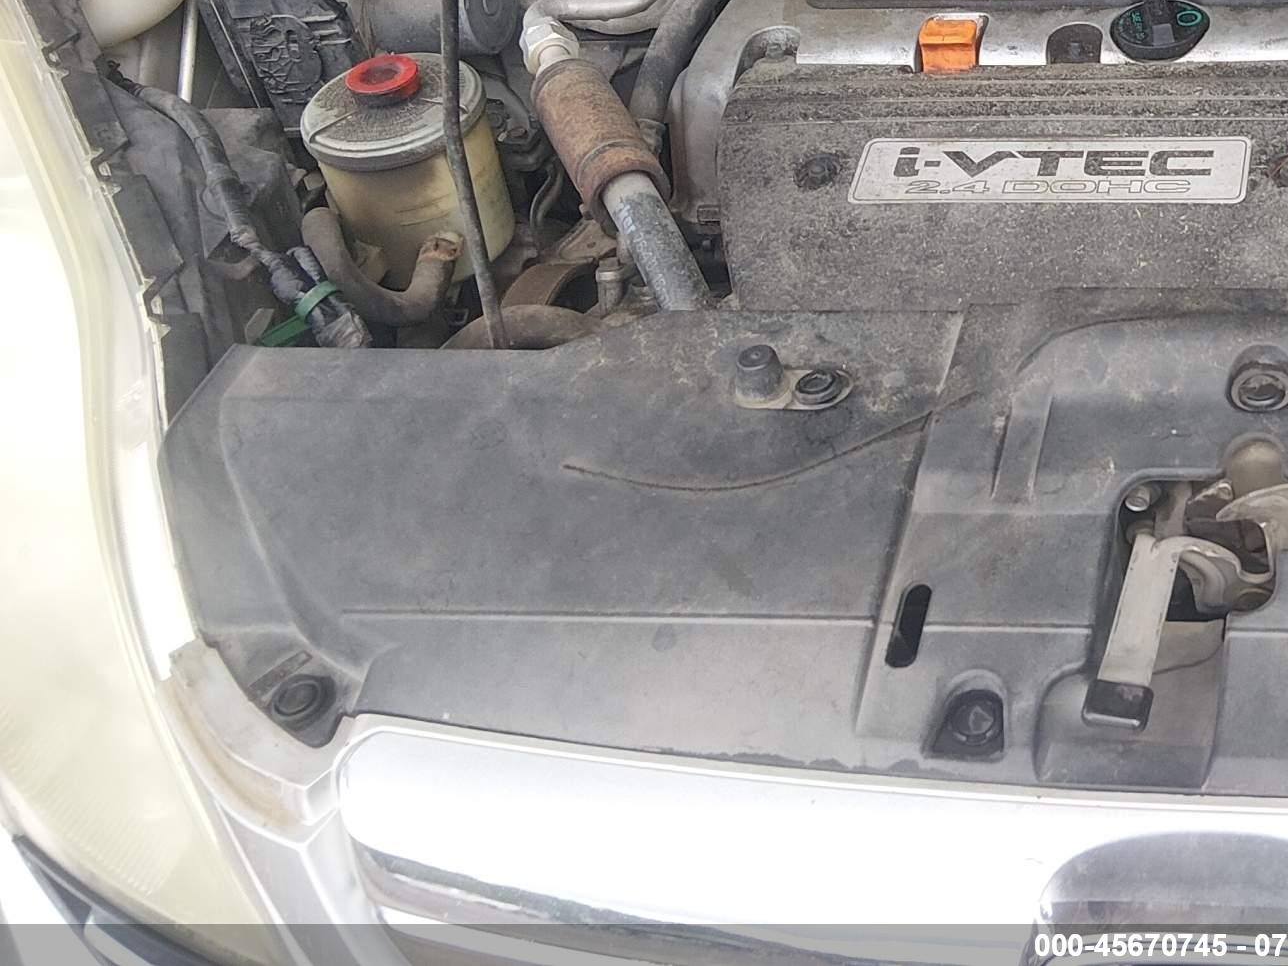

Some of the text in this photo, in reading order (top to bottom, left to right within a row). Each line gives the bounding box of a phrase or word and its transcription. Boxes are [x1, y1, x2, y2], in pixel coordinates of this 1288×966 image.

[893, 146, 1215, 178] i-VTEC
[904, 179, 1192, 195] 2.4 DOHC
